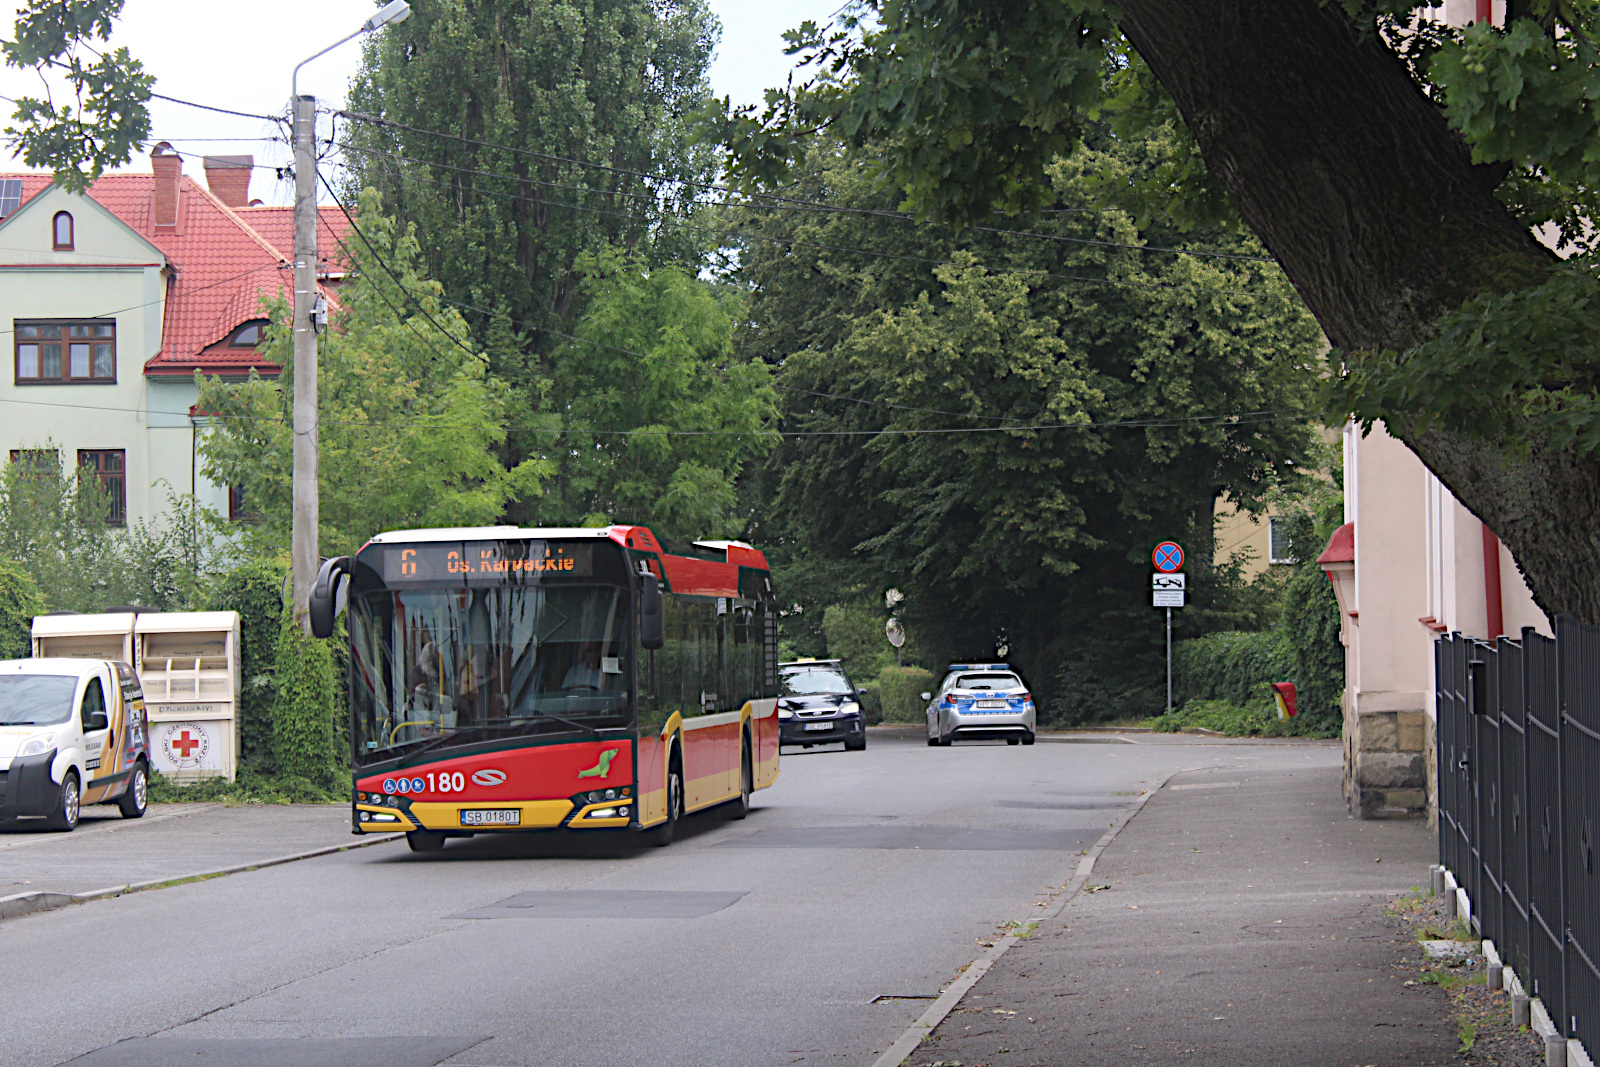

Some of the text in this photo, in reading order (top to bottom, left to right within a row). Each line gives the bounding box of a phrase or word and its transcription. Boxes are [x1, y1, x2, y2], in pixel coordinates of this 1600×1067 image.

[447, 548, 575, 573] Os. Karpackie
[167, 722, 206, 737] CZERWONY
[164, 739, 179, 764] POLSKI
[426, 772, 465, 793] 180
[467, 811, 518, 823] SB 0180T
